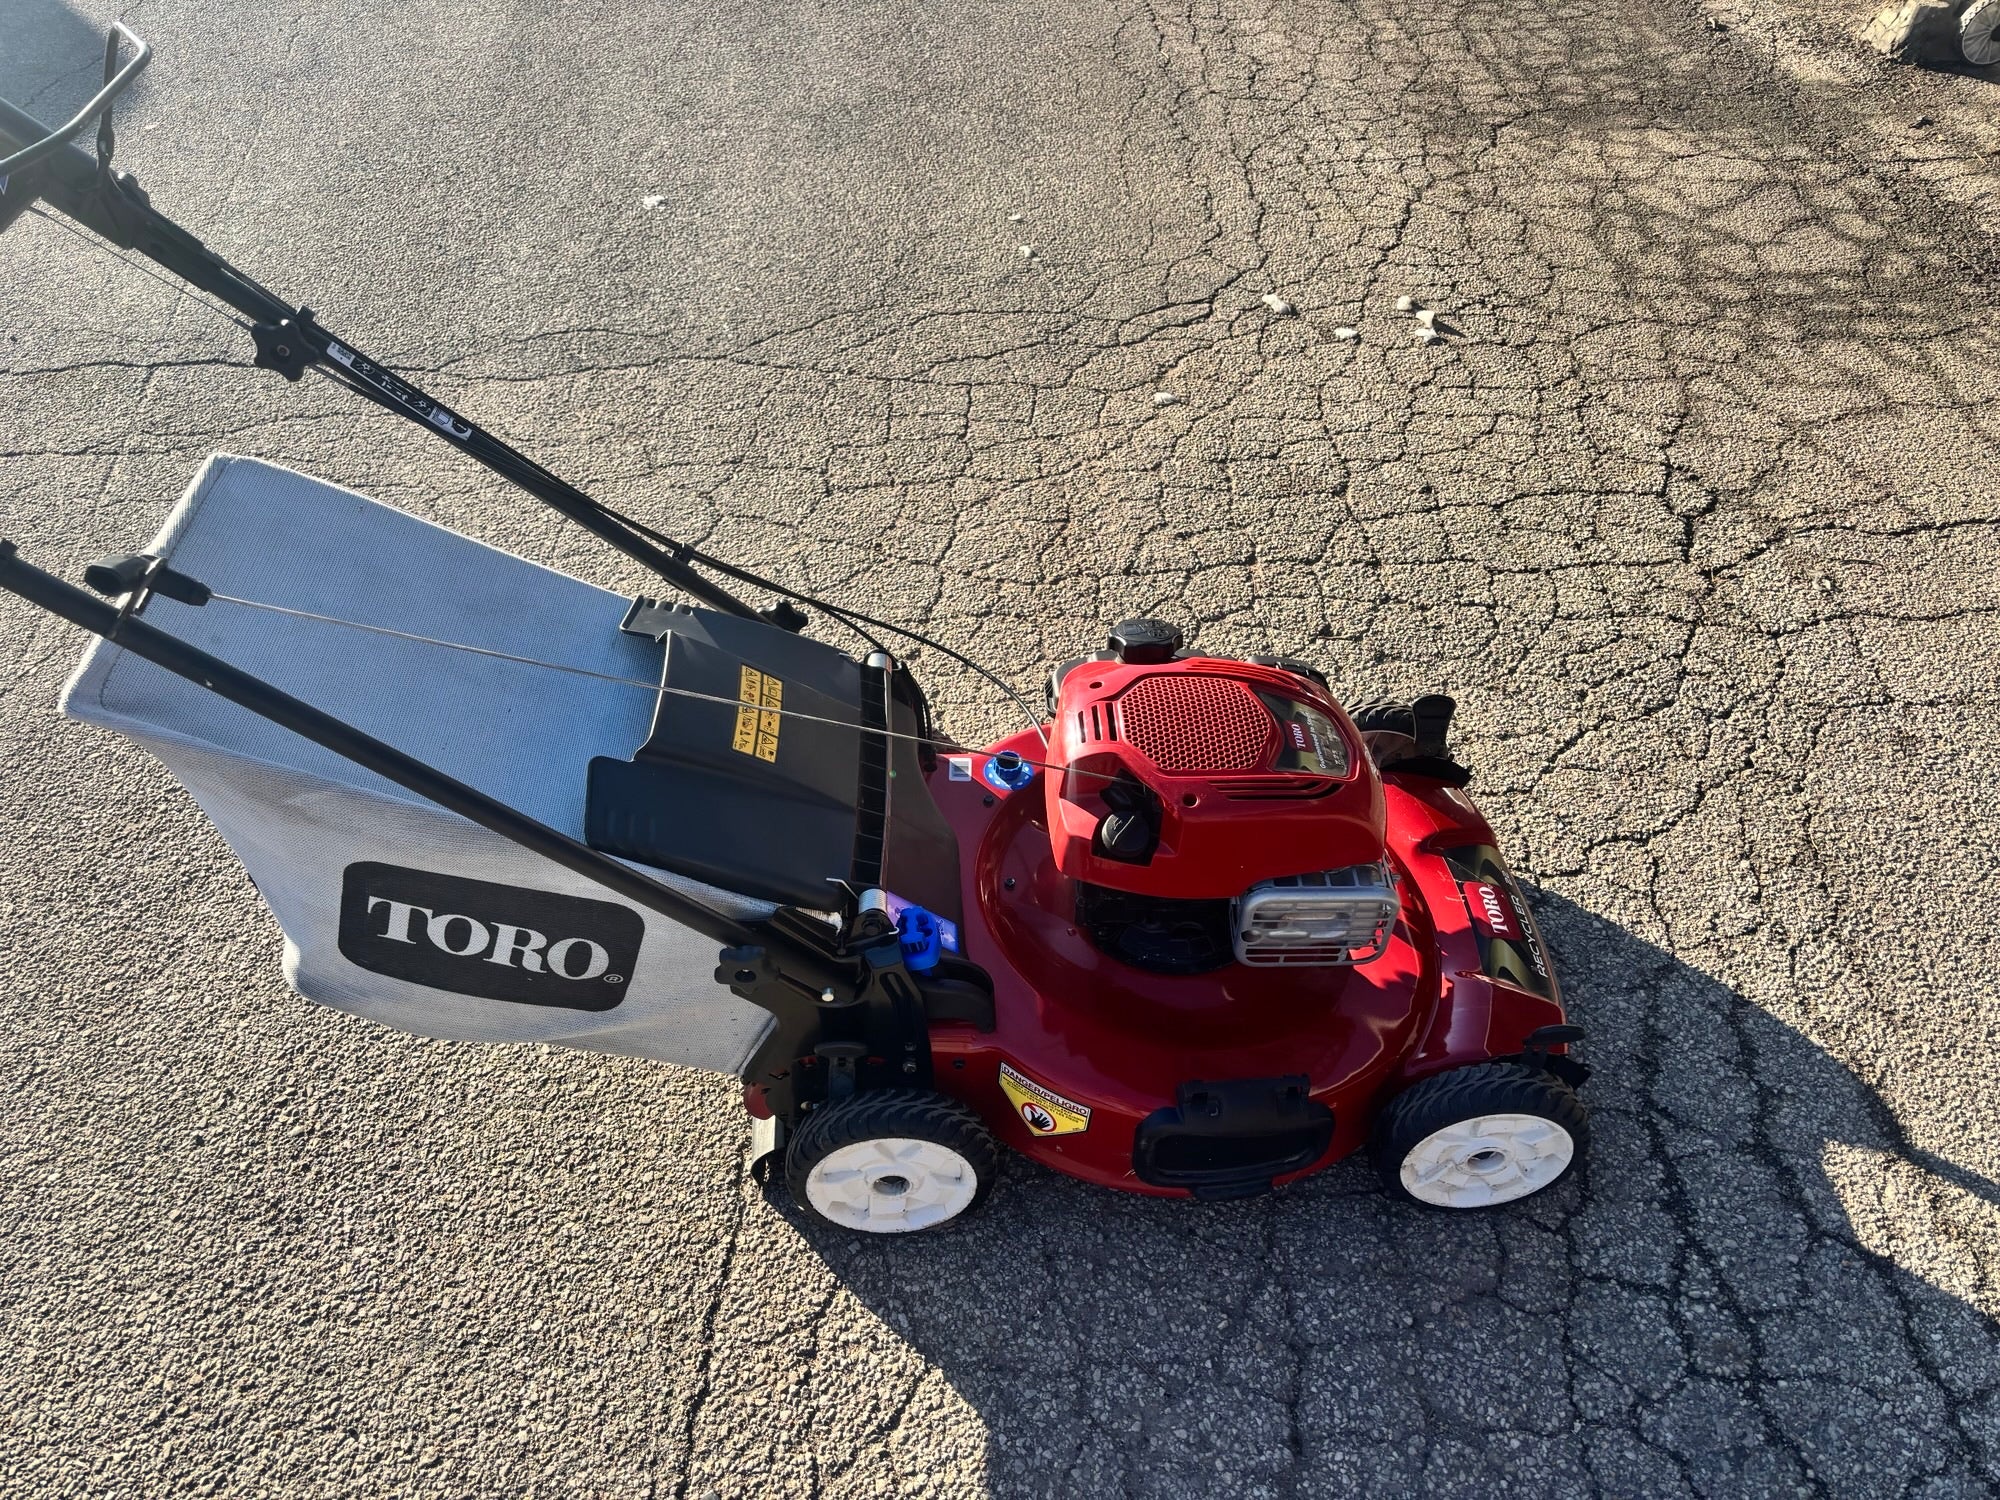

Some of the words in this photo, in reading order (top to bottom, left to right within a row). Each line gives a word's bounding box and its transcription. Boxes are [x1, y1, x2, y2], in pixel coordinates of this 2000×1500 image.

[1290, 723, 1306, 749] TORO
[1478, 886, 1510, 934] TORO
[367, 895, 610, 980] TORO
[1511, 895, 1549, 978] RECYCLER
[1003, 1066, 1088, 1115] DANGER/PELIGRO
